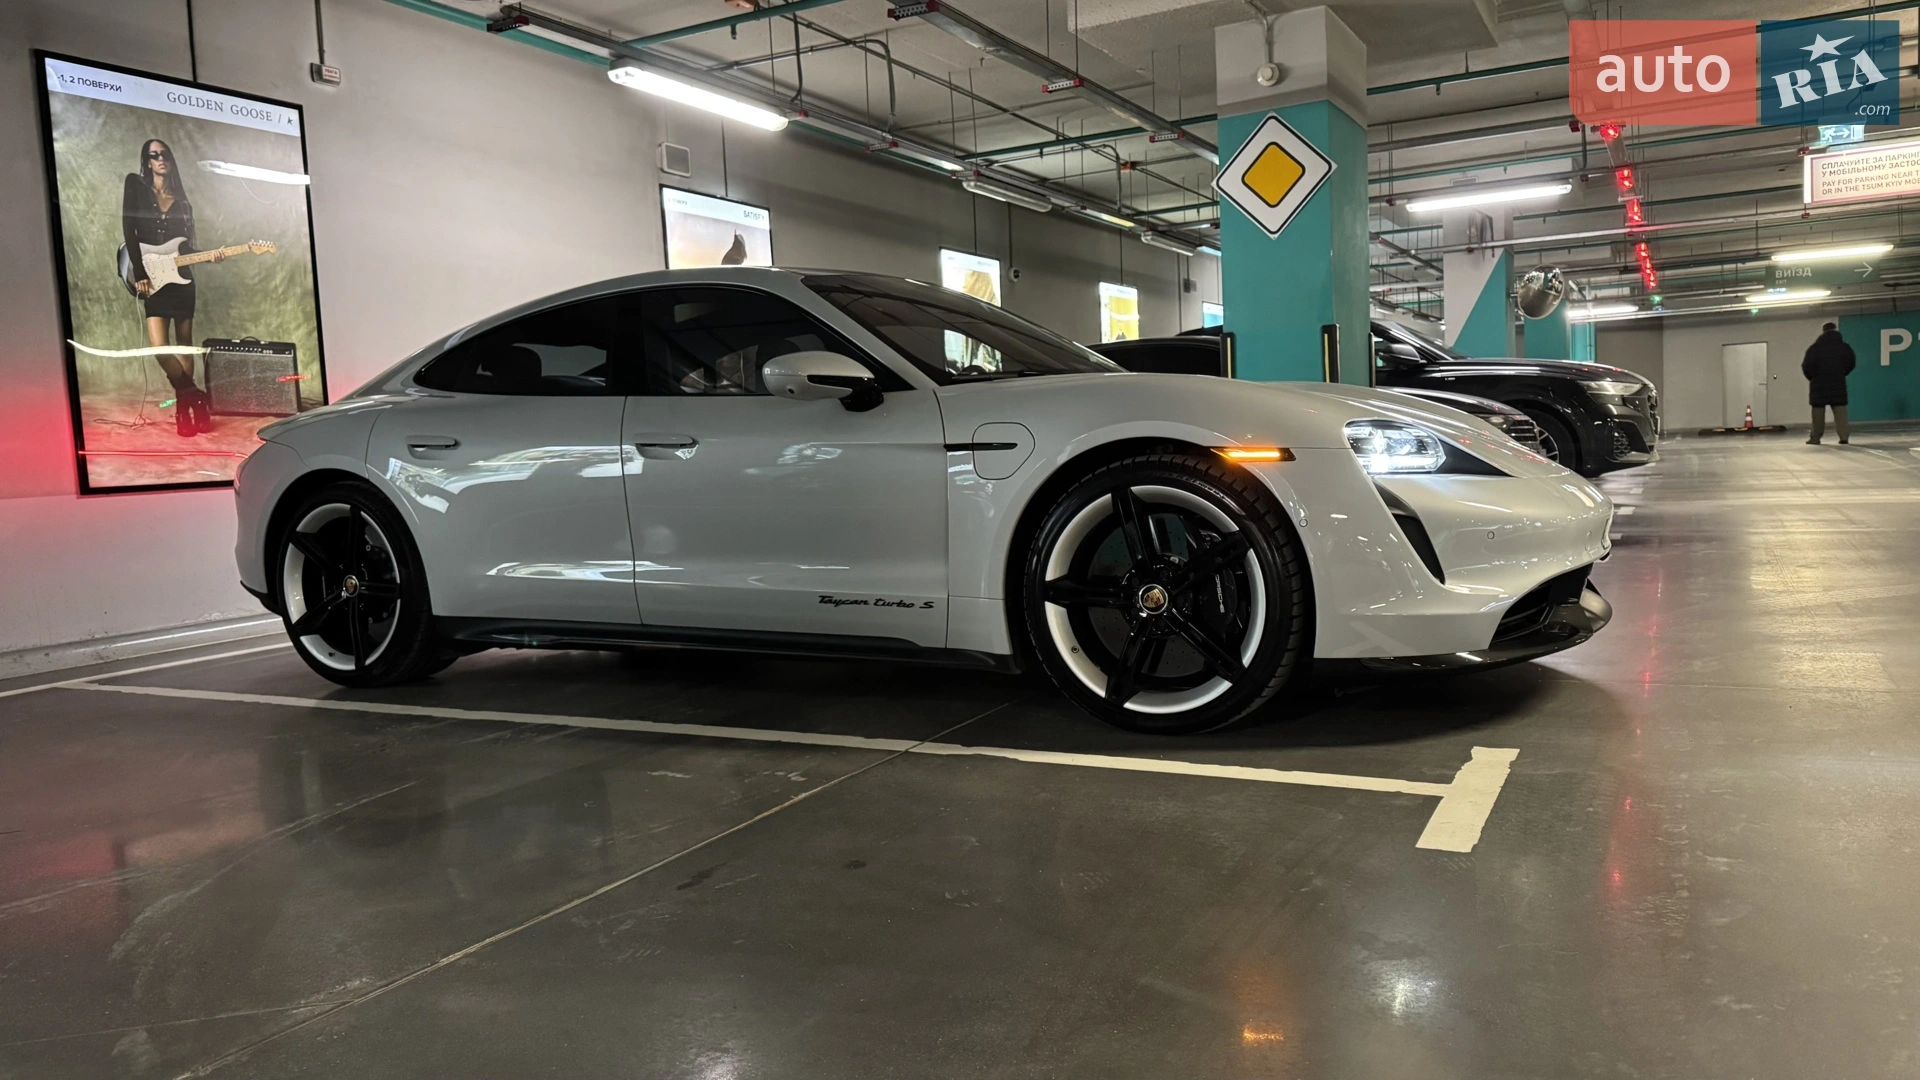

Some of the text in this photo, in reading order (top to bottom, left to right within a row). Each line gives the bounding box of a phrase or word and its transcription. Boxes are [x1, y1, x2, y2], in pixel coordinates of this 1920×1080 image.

[69, 75, 76, 84] 2
[77, 77, 122, 93] ПОВЕРХИ
[166, 91, 223, 112] GOLDEN
[230, 104, 272, 122] GOOSE
[1821, 157, 1871, 170] СПЛАЧУЙТЕ
[1872, 156, 1884, 164] ЗА
[1829, 163, 1887, 177] МОБІЛЬНОМУ
[1855, 173, 1890, 183] PARKING
[1891, 170, 1913, 179] NEAR
[1862, 182, 1884, 190] TSUM
[1885, 179, 1903, 188] KYIV
[1775, 267, 1812, 279] ВИЇЗД
[1880, 328, 1920, 366] P
[818, 595, 935, 609] Taycan turbo S
